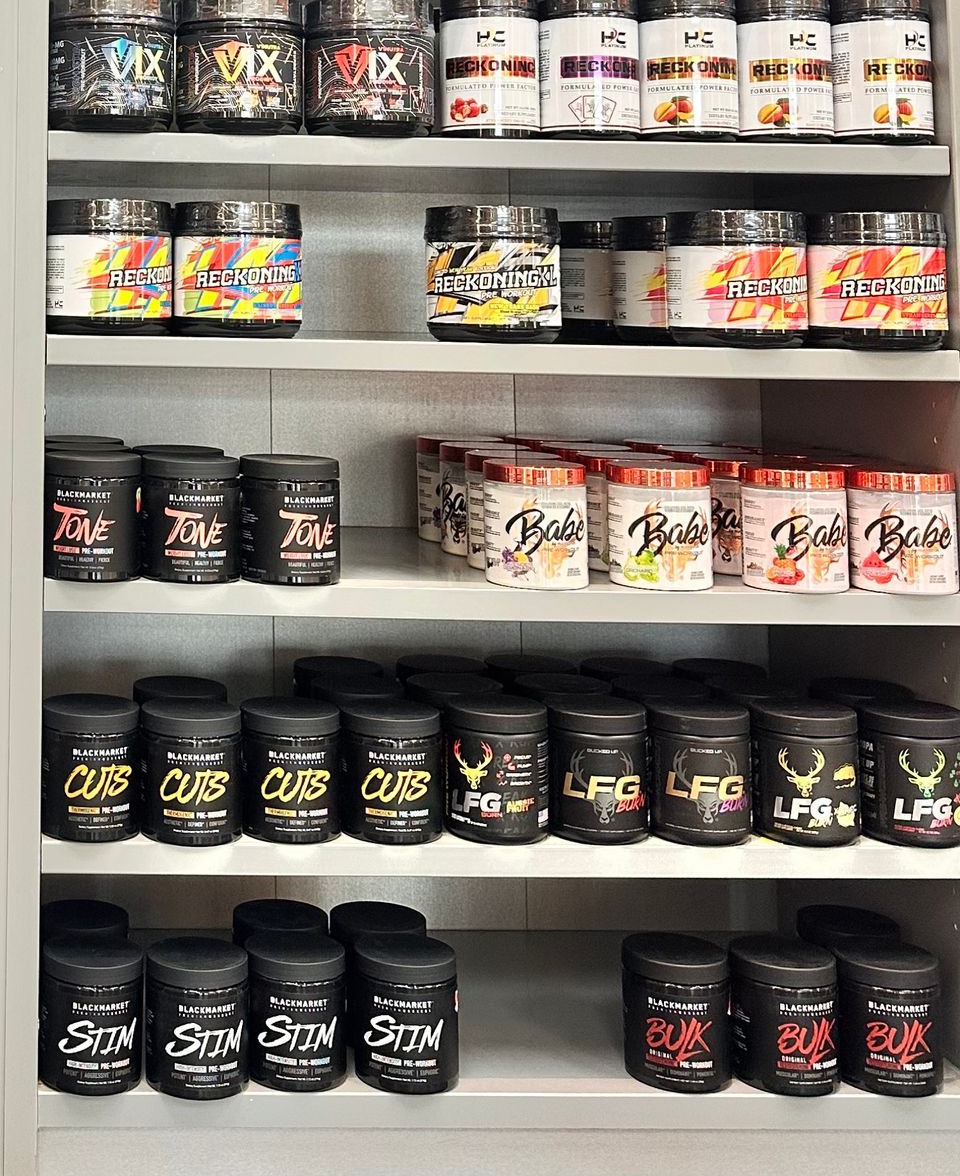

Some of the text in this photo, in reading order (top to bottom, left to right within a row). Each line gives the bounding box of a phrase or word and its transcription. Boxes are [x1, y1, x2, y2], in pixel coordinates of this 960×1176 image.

[196, 263, 296, 288] RECKONING
[434, 267, 540, 294] RECKONING
[840, 274, 946, 299] RECKONING
[480, 290, 497, 300] PRE
[56, 489, 112, 499] BLACKMARKET
[53, 502, 116, 545] TONE
[164, 506, 228, 549] TONE
[279, 508, 337, 550] TONE
[505, 507, 586, 555] Babe
[628, 510, 709, 557] Babe
[864, 514, 953, 564] Babe
[63, 764, 132, 801] CUTS
[159, 767, 230, 805] CUTS
[260, 767, 331, 805] CUTS
[360, 767, 432, 805] CUTS
[563, 771, 641, 801] LFG
[665, 770, 744, 801] LFG
[451, 788, 502, 813] LFG
[773, 795, 833, 821] LFG
[893, 797, 953, 822] LFG
[72, 1001, 129, 1012] BLACKMARKET
[178, 1003, 236, 1014] BLACKMARKET
[270, 995, 328, 1007] BLACKMARKET
[373, 995, 432, 1007] BLACKMARKET
[648, 997, 709, 1011] BLACKMARKET
[779, 1001, 834, 1014] BLACKMARKET
[868, 1000, 929, 1014] BLACKMARKET
[58, 1018, 135, 1055] STIM
[165, 1019, 242, 1061] STIM
[257, 1014, 337, 1053] STIM
[363, 1014, 444, 1053] STIM
[645, 1016, 712, 1064] BULK
[777, 1017, 836, 1065] BULK
[865, 1019, 933, 1065] BULK
